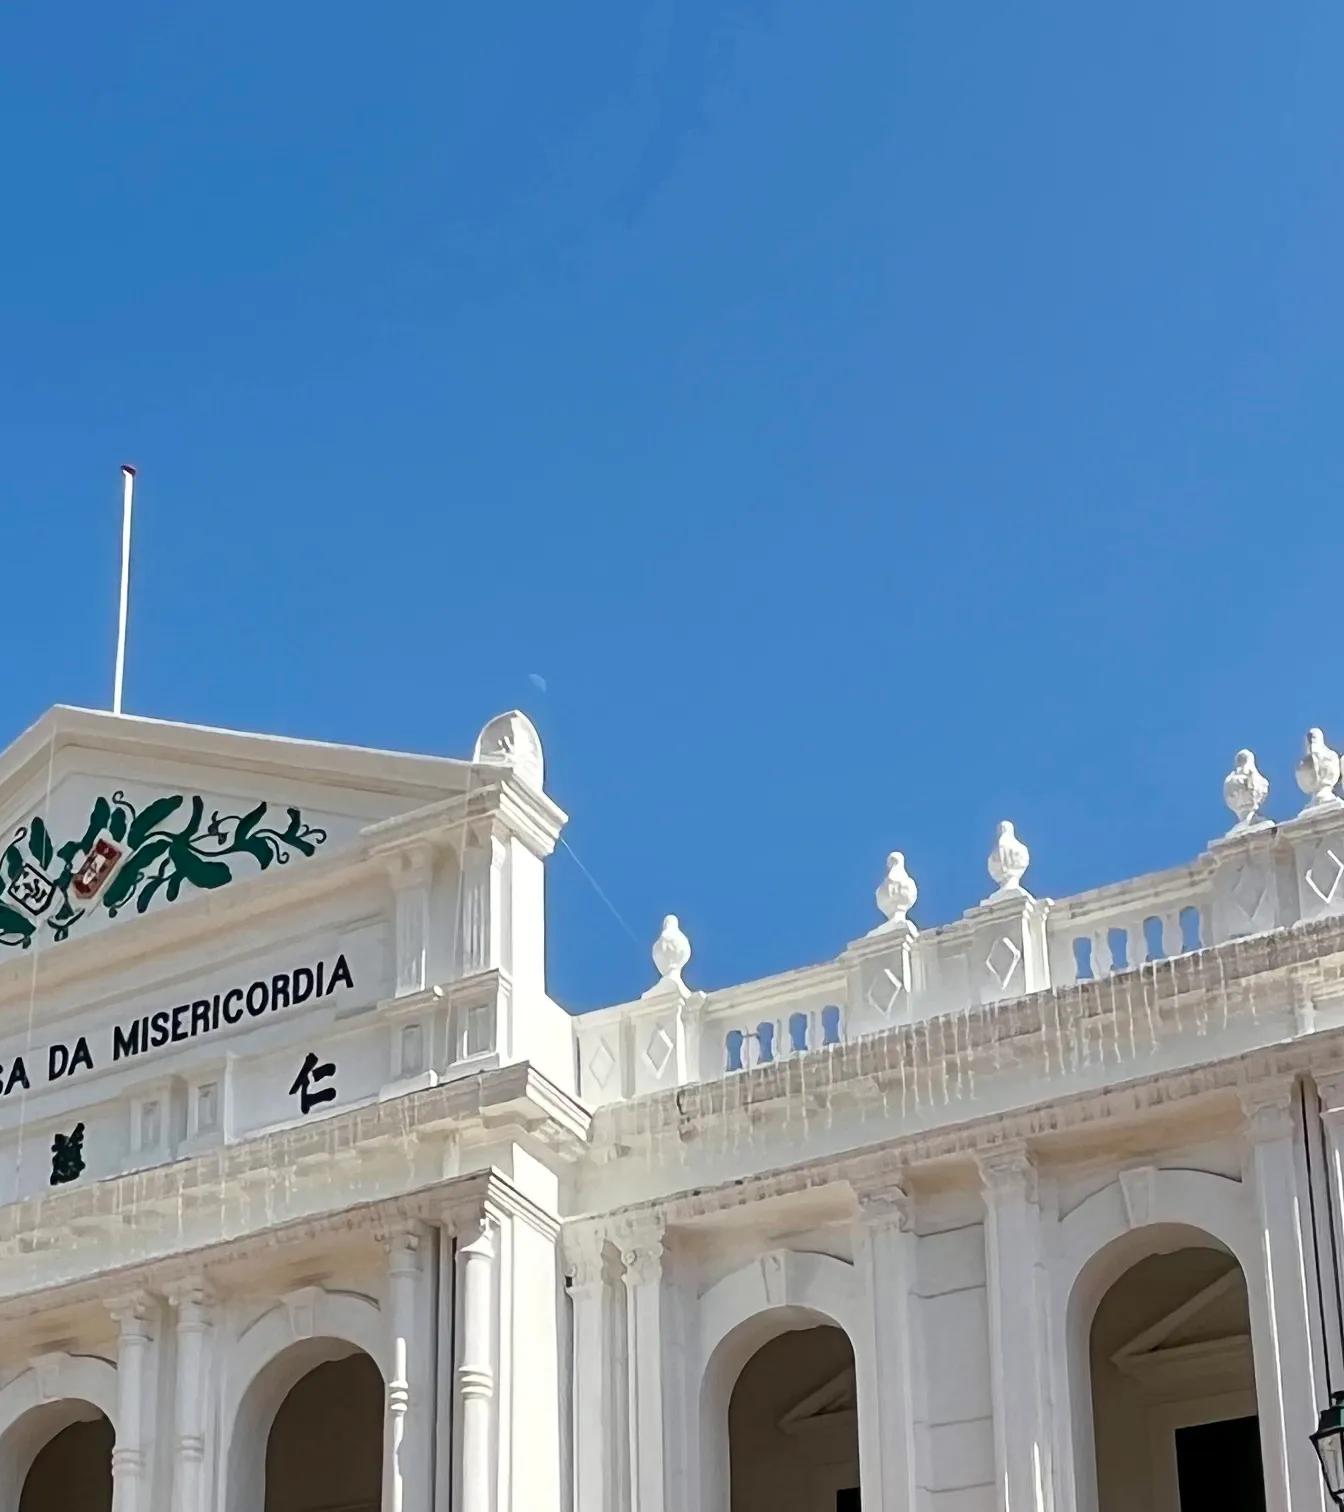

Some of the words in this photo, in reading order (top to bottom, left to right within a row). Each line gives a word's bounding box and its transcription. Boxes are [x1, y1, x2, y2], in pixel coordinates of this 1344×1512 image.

[48, 1036, 94, 1081] DA
[113, 954, 354, 1061] MISERICORDIA
[288, 1052, 337, 1115] 仁
